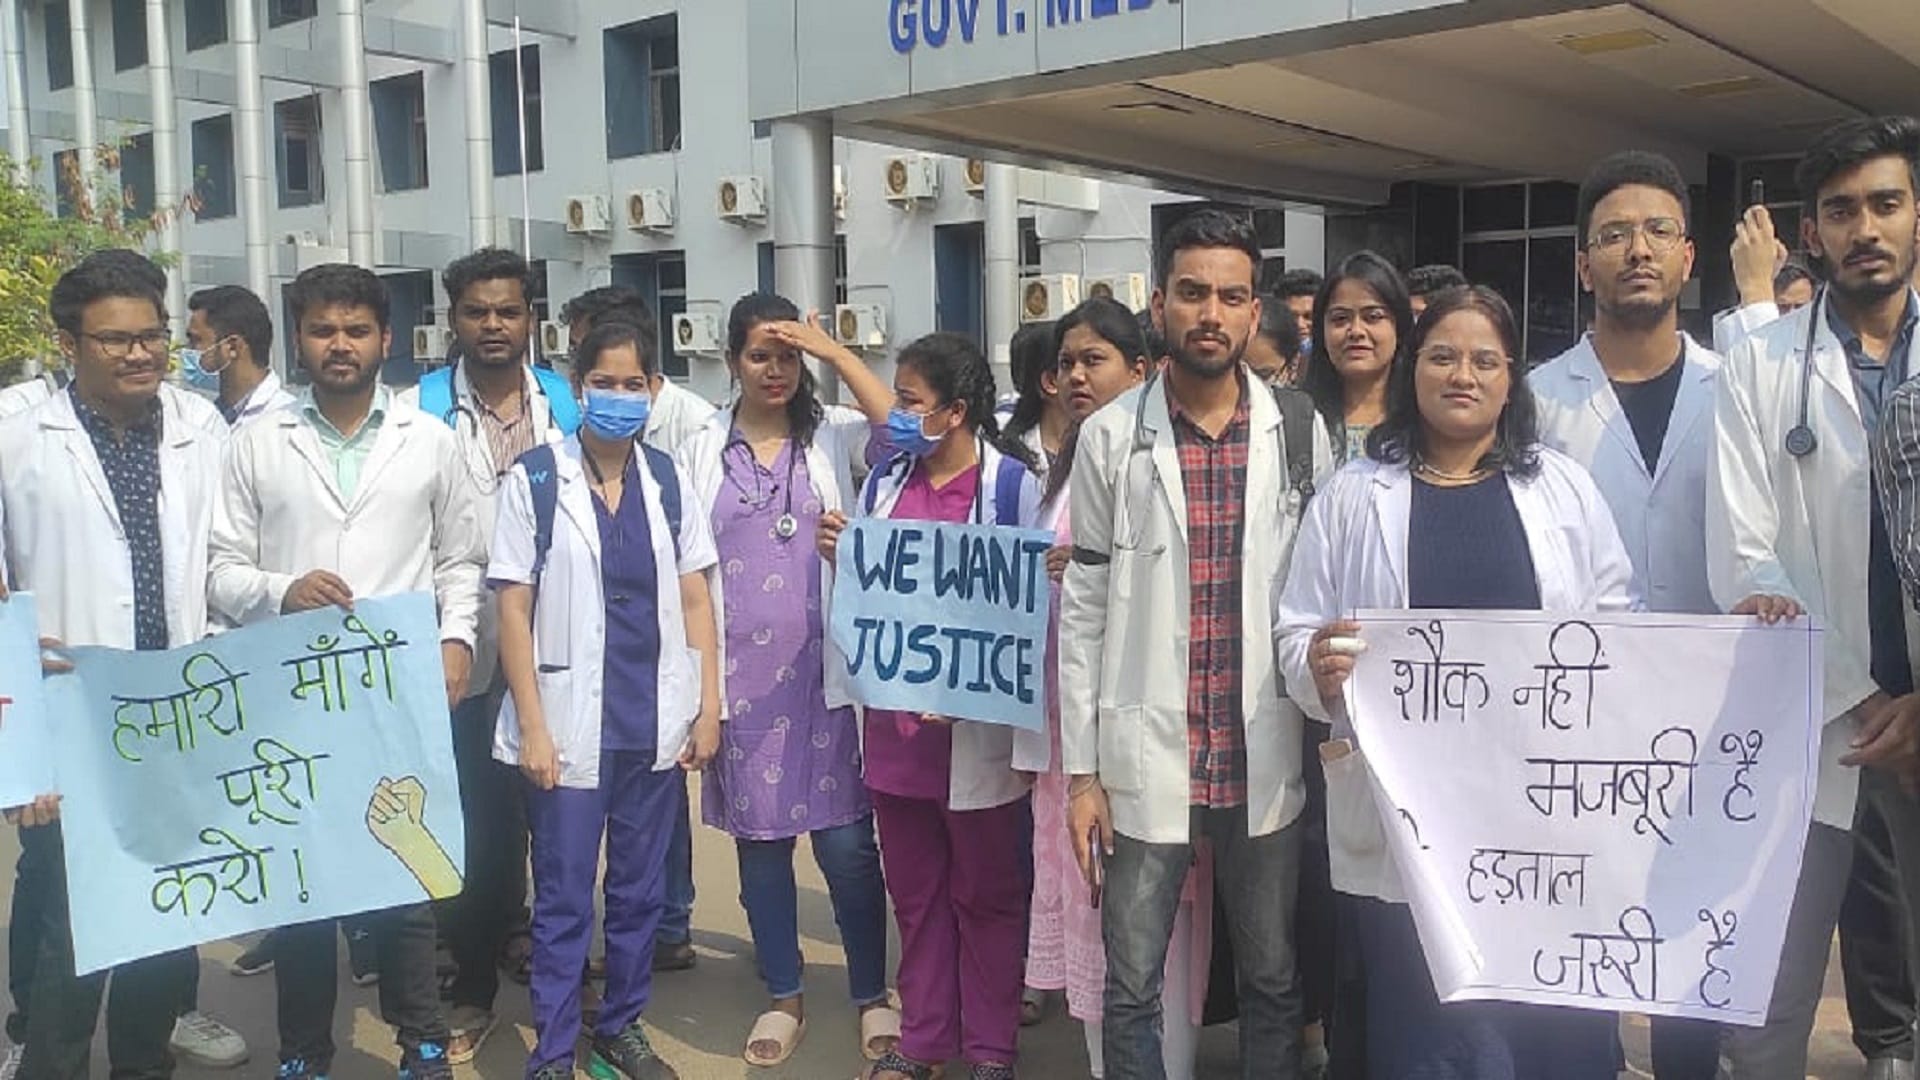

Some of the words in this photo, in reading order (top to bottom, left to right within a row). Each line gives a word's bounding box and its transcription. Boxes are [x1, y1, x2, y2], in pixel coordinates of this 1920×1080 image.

[854, 527, 923, 594] WE
[934, 528, 1053, 613] WANT
[111, 653, 249, 761] हमारी
[281, 614, 408, 711] माँगें
[847, 618, 1034, 704] JUSTICE
[1391, 620, 1489, 723] शौक
[1513, 620, 1609, 730] नहीं
[216, 738, 331, 824] पूरी
[1525, 727, 1698, 845] मजबूरी
[1720, 730, 1763, 822] है
[1467, 848, 1593, 906] हड़ताल
[1698, 908, 1738, 1008] है
